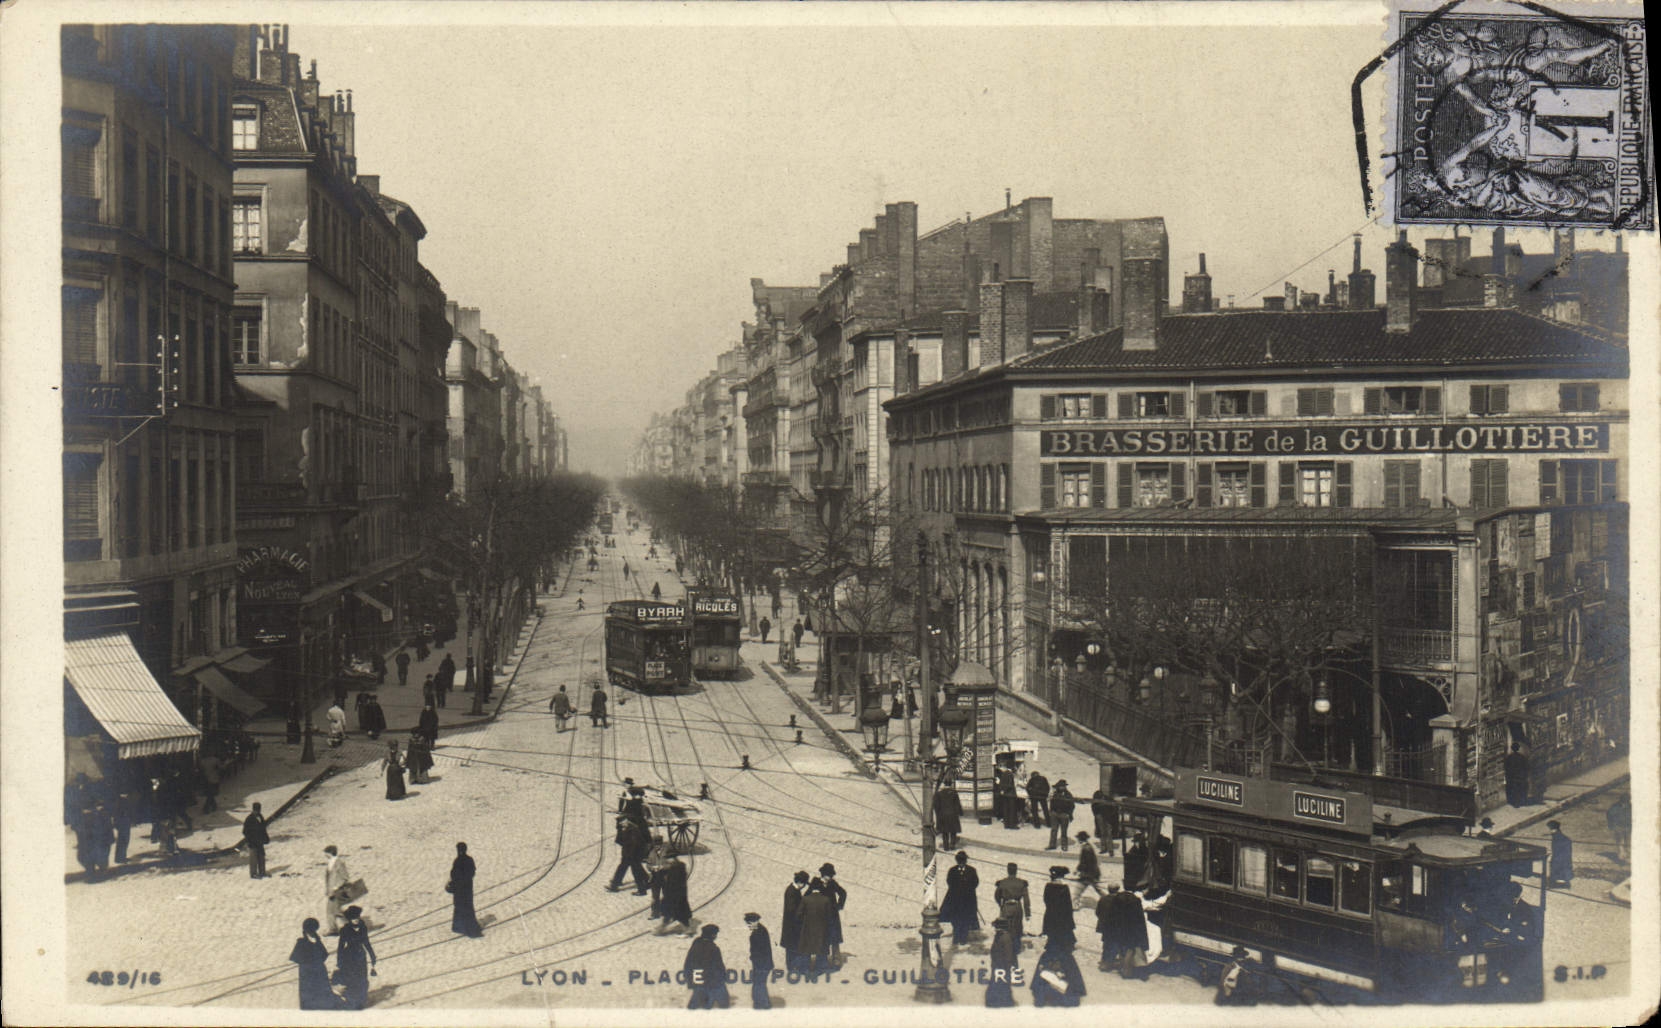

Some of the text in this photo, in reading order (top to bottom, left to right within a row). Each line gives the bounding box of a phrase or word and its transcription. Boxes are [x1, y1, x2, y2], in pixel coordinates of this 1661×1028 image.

[1414, 75, 1434, 161] POSTE
[1534, 110, 1614, 142] 1
[1051, 424, 1600, 453] BRASSERIE de la GUILLOTIÈRE
[236, 546, 309, 574] PHARMACIE
[637, 607, 685, 618] BYRRH
[1200, 781, 1240, 801] LUCILINE
[1298, 797, 1341, 819] LUCILINE
